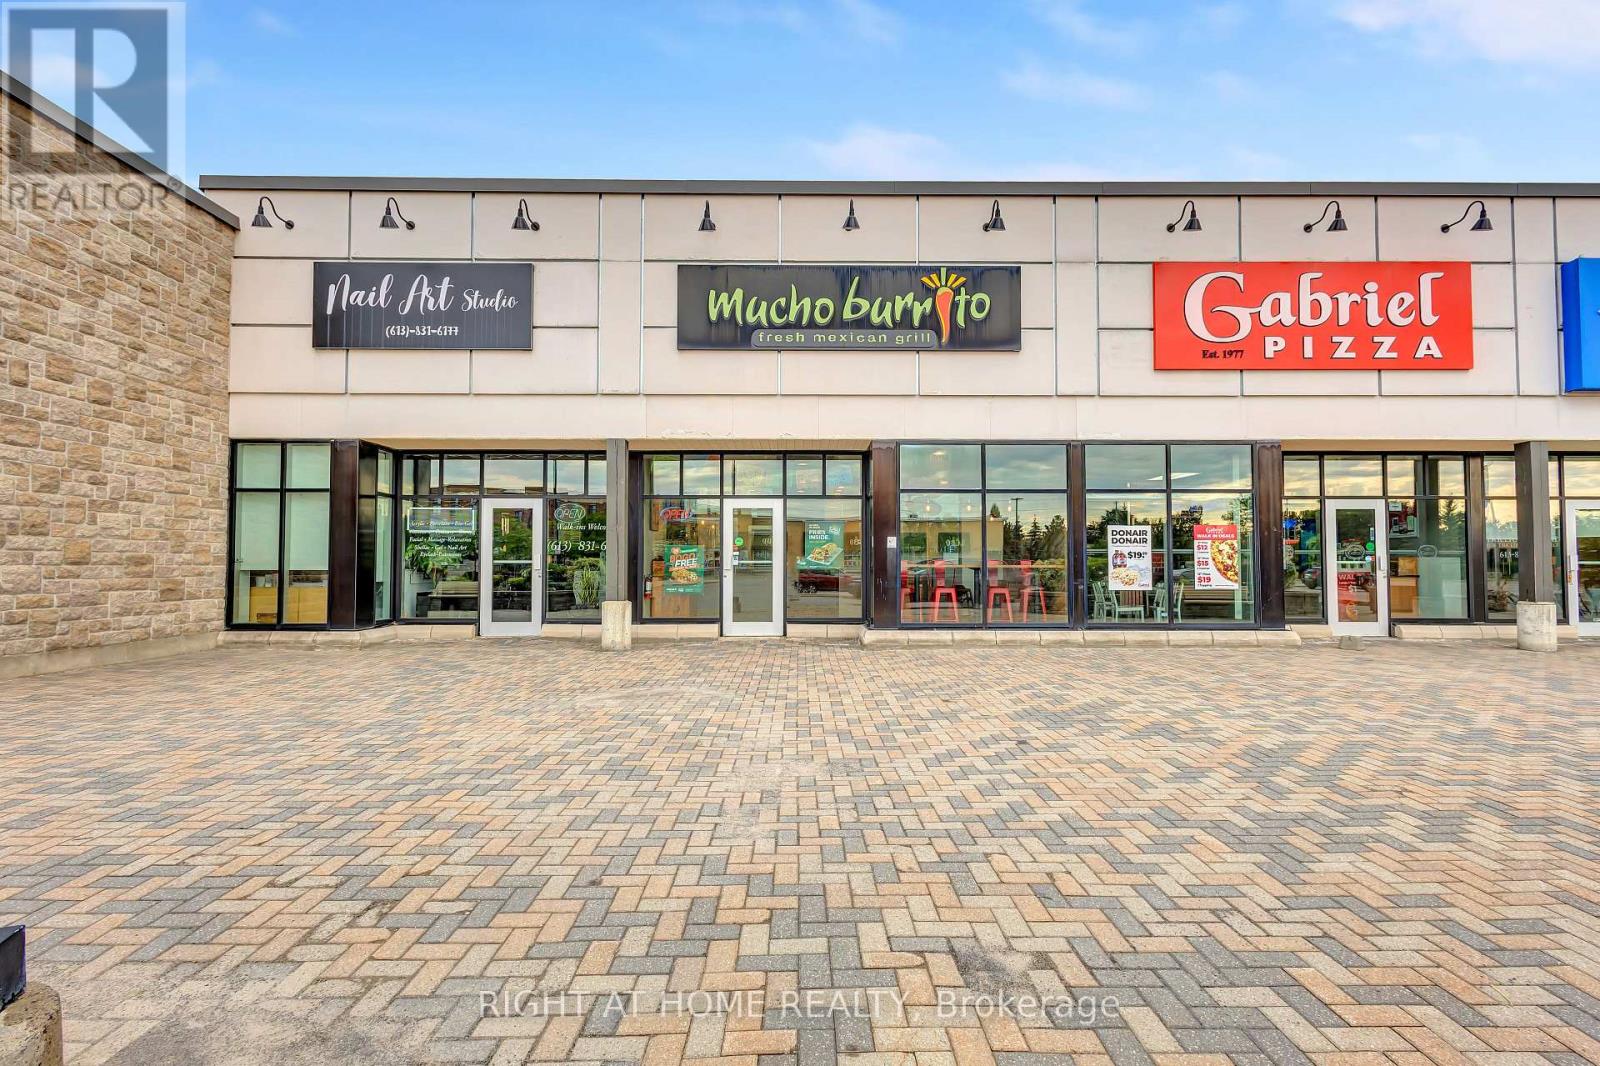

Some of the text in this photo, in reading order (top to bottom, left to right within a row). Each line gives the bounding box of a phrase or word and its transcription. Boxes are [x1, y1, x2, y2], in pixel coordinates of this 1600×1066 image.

[327, 273, 518, 315] Nail Art Studio
[1183, 271, 1445, 343] Gabriel
[758, 331, 931, 345] fresh mexican grill
[1263, 336, 1443, 359] PIZZA
[1201, 350, 1245, 360] Est. 1977
[547, 540, 572, 552] (613)
[674, 558, 698, 568] FREE
